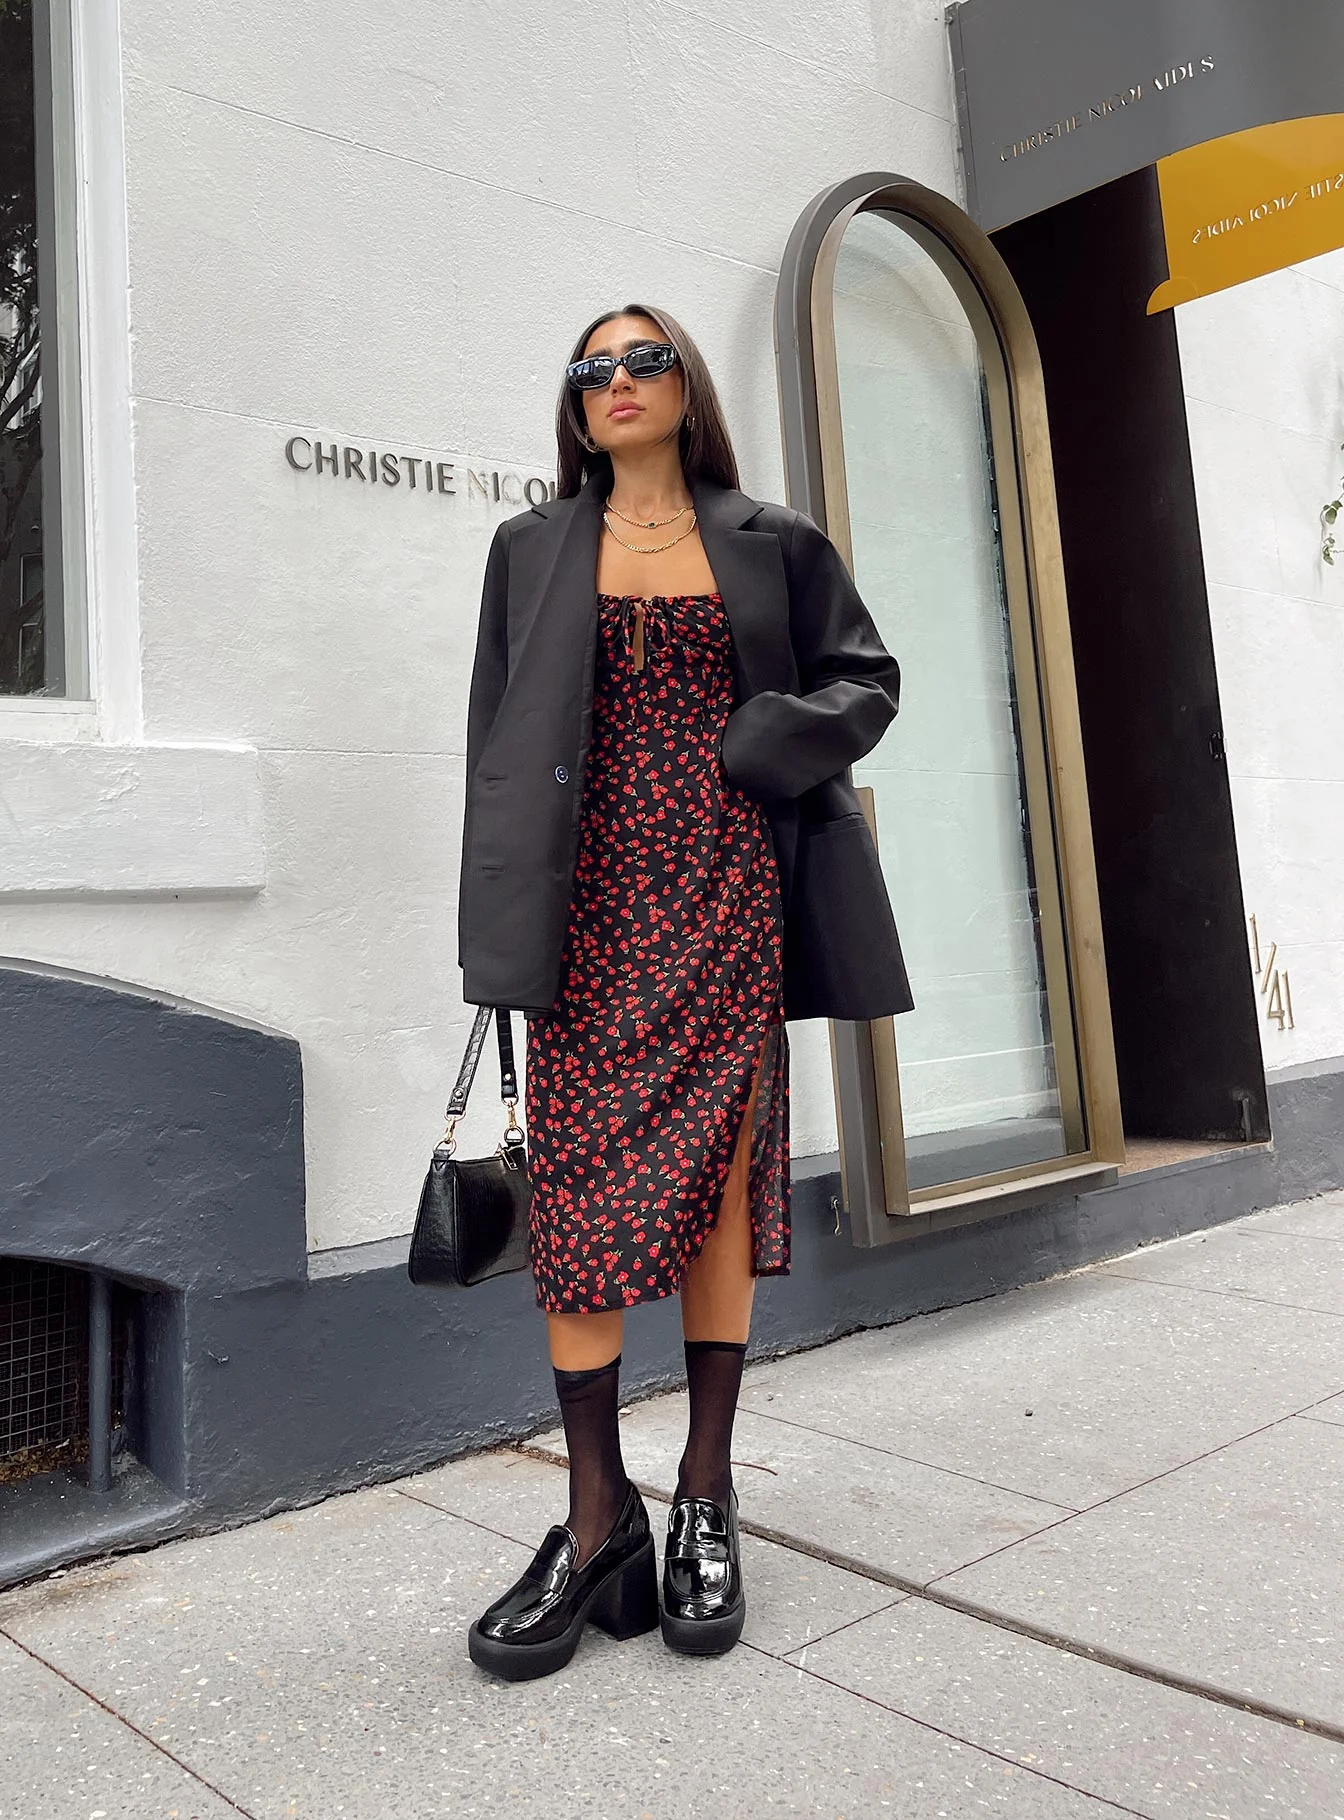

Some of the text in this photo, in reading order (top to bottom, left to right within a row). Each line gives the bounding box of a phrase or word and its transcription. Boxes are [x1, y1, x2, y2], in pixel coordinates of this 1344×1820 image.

[1000, 112, 1083, 162] CHRISTIE
[285, 436, 457, 495] CHRISTIE
[1250, 912, 1295, 1031] 1/41
